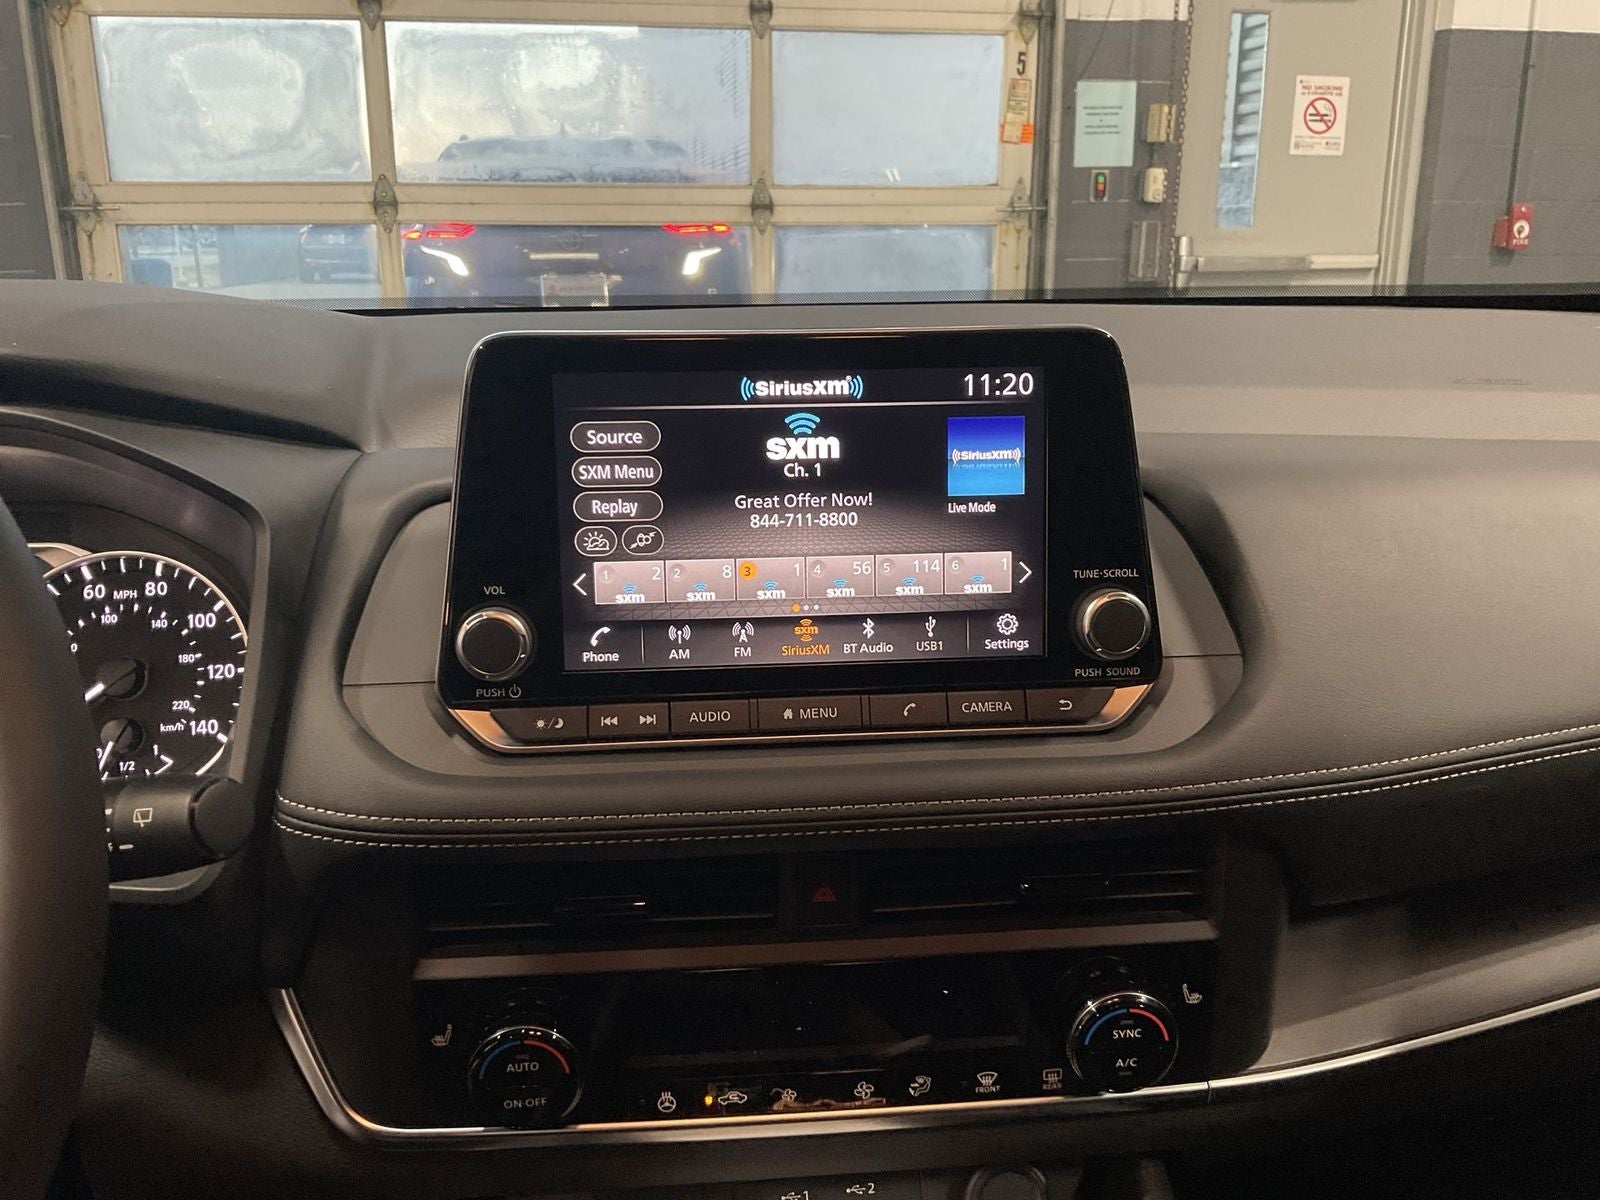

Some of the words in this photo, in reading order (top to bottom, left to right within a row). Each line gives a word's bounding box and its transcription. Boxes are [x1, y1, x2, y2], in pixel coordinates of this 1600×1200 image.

[1016, 51, 1027, 76] 5
[963, 372, 1034, 396] 11:20
[586, 429, 643, 445] Source
[765, 435, 841, 462] sxm
[578, 464, 611, 480] SXM
[614, 463, 654, 479] Menu
[783, 462, 809, 478] Ch.
[813, 462, 822, 477] 1
[734, 494, 780, 509] Great
[784, 493, 828, 508] Offer
[831, 492, 873, 507] Now!
[591, 498, 639, 517] Replay
[948, 502, 967, 513] Live
[968, 502, 996, 513] Mode
[749, 512, 858, 528] 844-711-8800
[793, 563, 800, 577] 1
[813, 564, 822, 574] 4
[852, 561, 872, 575] 56
[883, 563, 890, 573] 5
[913, 559, 941, 573] 114
[951, 560, 959, 571] 6
[1001, 557, 1008, 571] 1
[602, 570, 608, 580] 1
[651, 567, 661, 580] 2
[673, 568, 681, 579] 2
[722, 564, 732, 579] 8
[744, 566, 751, 577] 3
[83, 584, 106, 599] 60
[113, 588, 138, 600] MPH
[145, 581, 168, 597] 80
[483, 585, 506, 596] VOL
[756, 588, 786, 600] sxm
[826, 586, 855, 597] sxm
[895, 584, 924, 596] sxm
[963, 583, 993, 594] sxm
[615, 592, 646, 603] sxm
[686, 590, 716, 602] sxm
[100, 613, 118, 625] 100
[151, 618, 168, 629] 140
[187, 612, 217, 629] 100
[781, 644, 830, 656] SiriusXM
[843, 643, 857, 654] BT
[859, 642, 894, 653] Audio
[916, 641, 943, 651] USB1
[984, 639, 1029, 652] Settings
[582, 650, 620, 662] Phone
[669, 648, 691, 660] AM
[734, 646, 752, 658] FM
[178, 654, 195, 664] 180
[207, 663, 235, 680] 120
[1074, 668, 1102, 678] PUSH
[1106, 666, 1141, 677] SOUND
[475, 688, 505, 698] PUSH
[172, 699, 190, 711] 220
[961, 700, 1013, 714] CAMERA
[689, 710, 731, 723] AUDIO
[799, 707, 838, 720] MENU
[160, 722, 185, 733] km/h
[189, 719, 218, 736] 140
[119, 760, 135, 772] 1/2
[1112, 1028, 1142, 1040] SYNC
[506, 1062, 540, 1072] AUTO
[1115, 1057, 1138, 1068] A/C
[975, 1085, 1001, 1094] FRONT
[867, 1182, 876, 1194] 2
[803, 1190, 809, 1200] 1
